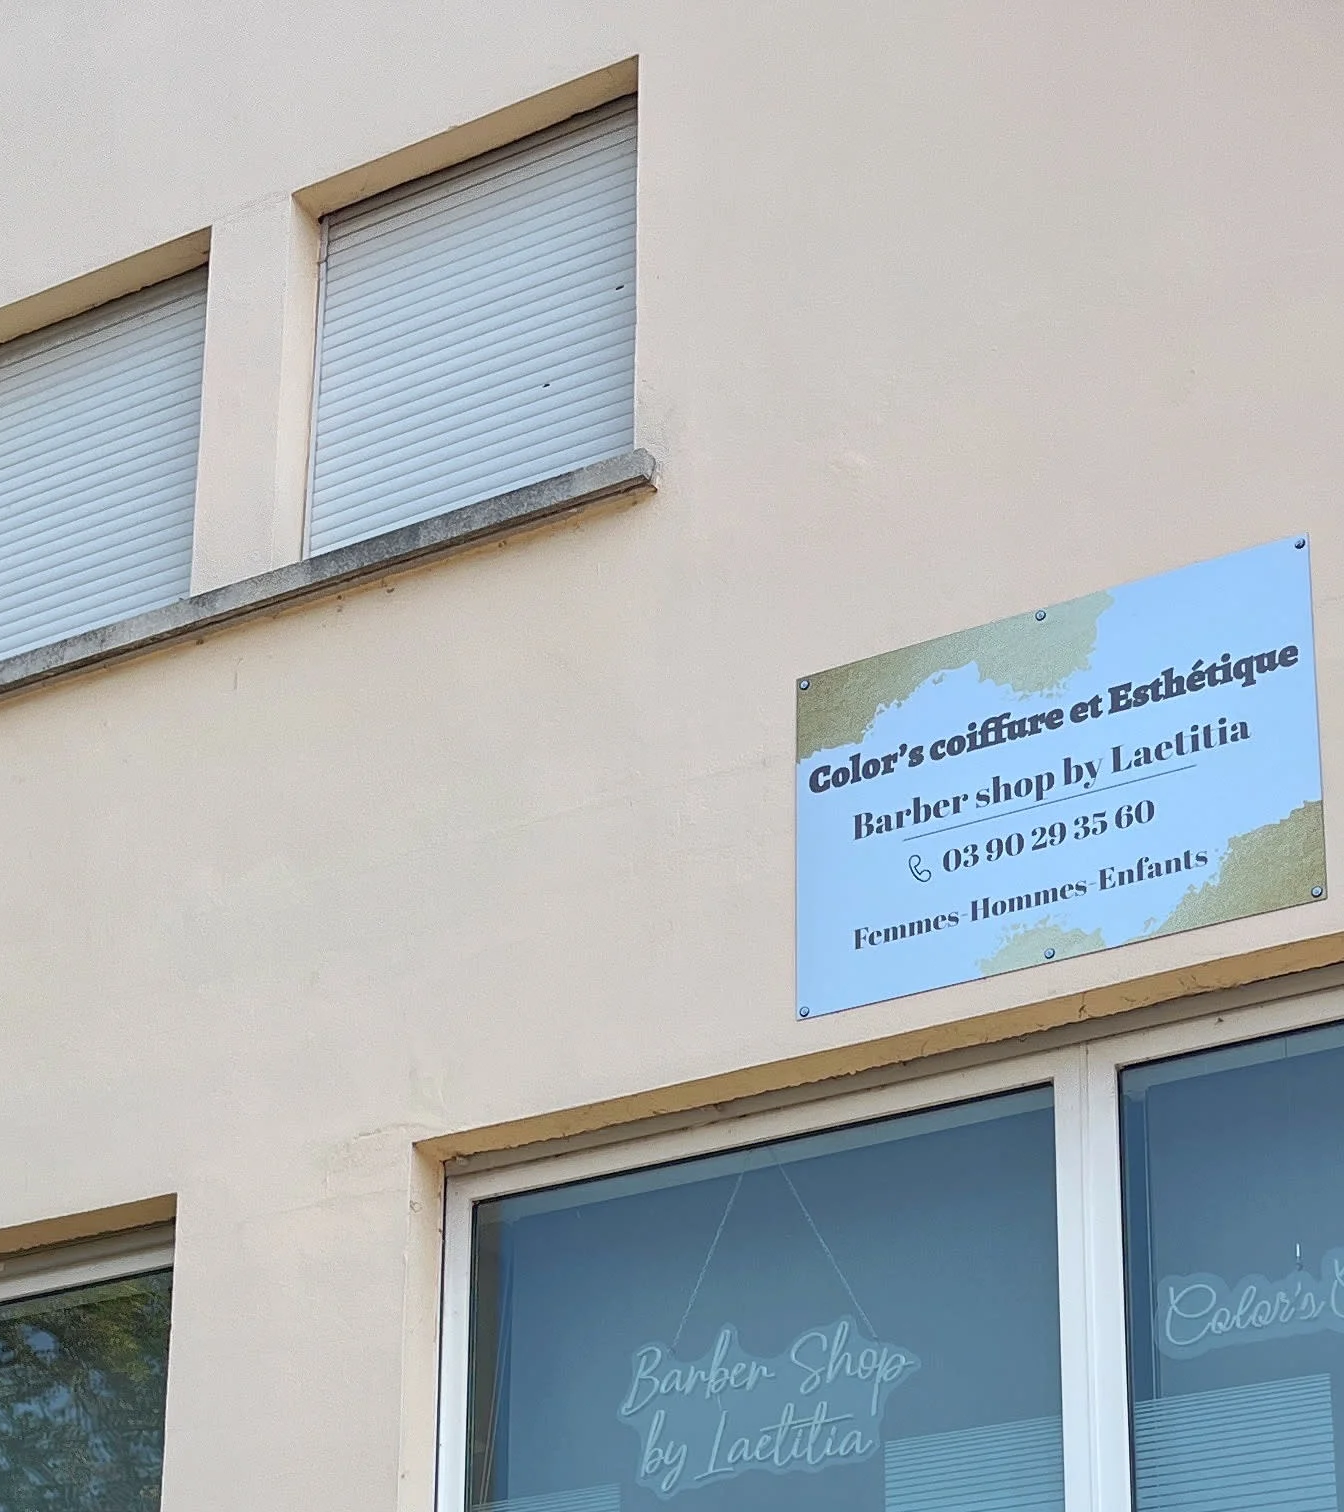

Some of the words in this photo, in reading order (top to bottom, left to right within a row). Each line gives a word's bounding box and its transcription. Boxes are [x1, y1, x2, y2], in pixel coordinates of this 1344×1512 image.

[809, 744, 924, 793] Color's
[929, 707, 1064, 761] coiffure
[1069, 694, 1103, 723] et
[1107, 645, 1299, 715] Esthétique
[853, 791, 969, 841] Barber
[975, 775, 1055, 809] shop
[1063, 757, 1103, 789] by
[1111, 717, 1251, 774] Laetitia
[942, 843, 980, 872] 03
[986, 832, 1025, 861] 90
[1031, 822, 1067, 851] 29
[1073, 810, 1108, 840] 35
[1114, 800, 1155, 829] 60
[620, 1328, 776, 1416] Barber
[790, 1320, 915, 1417] Shop
[639, 1409, 687, 1492] by
[693, 1401, 874, 1481] Laetitia
